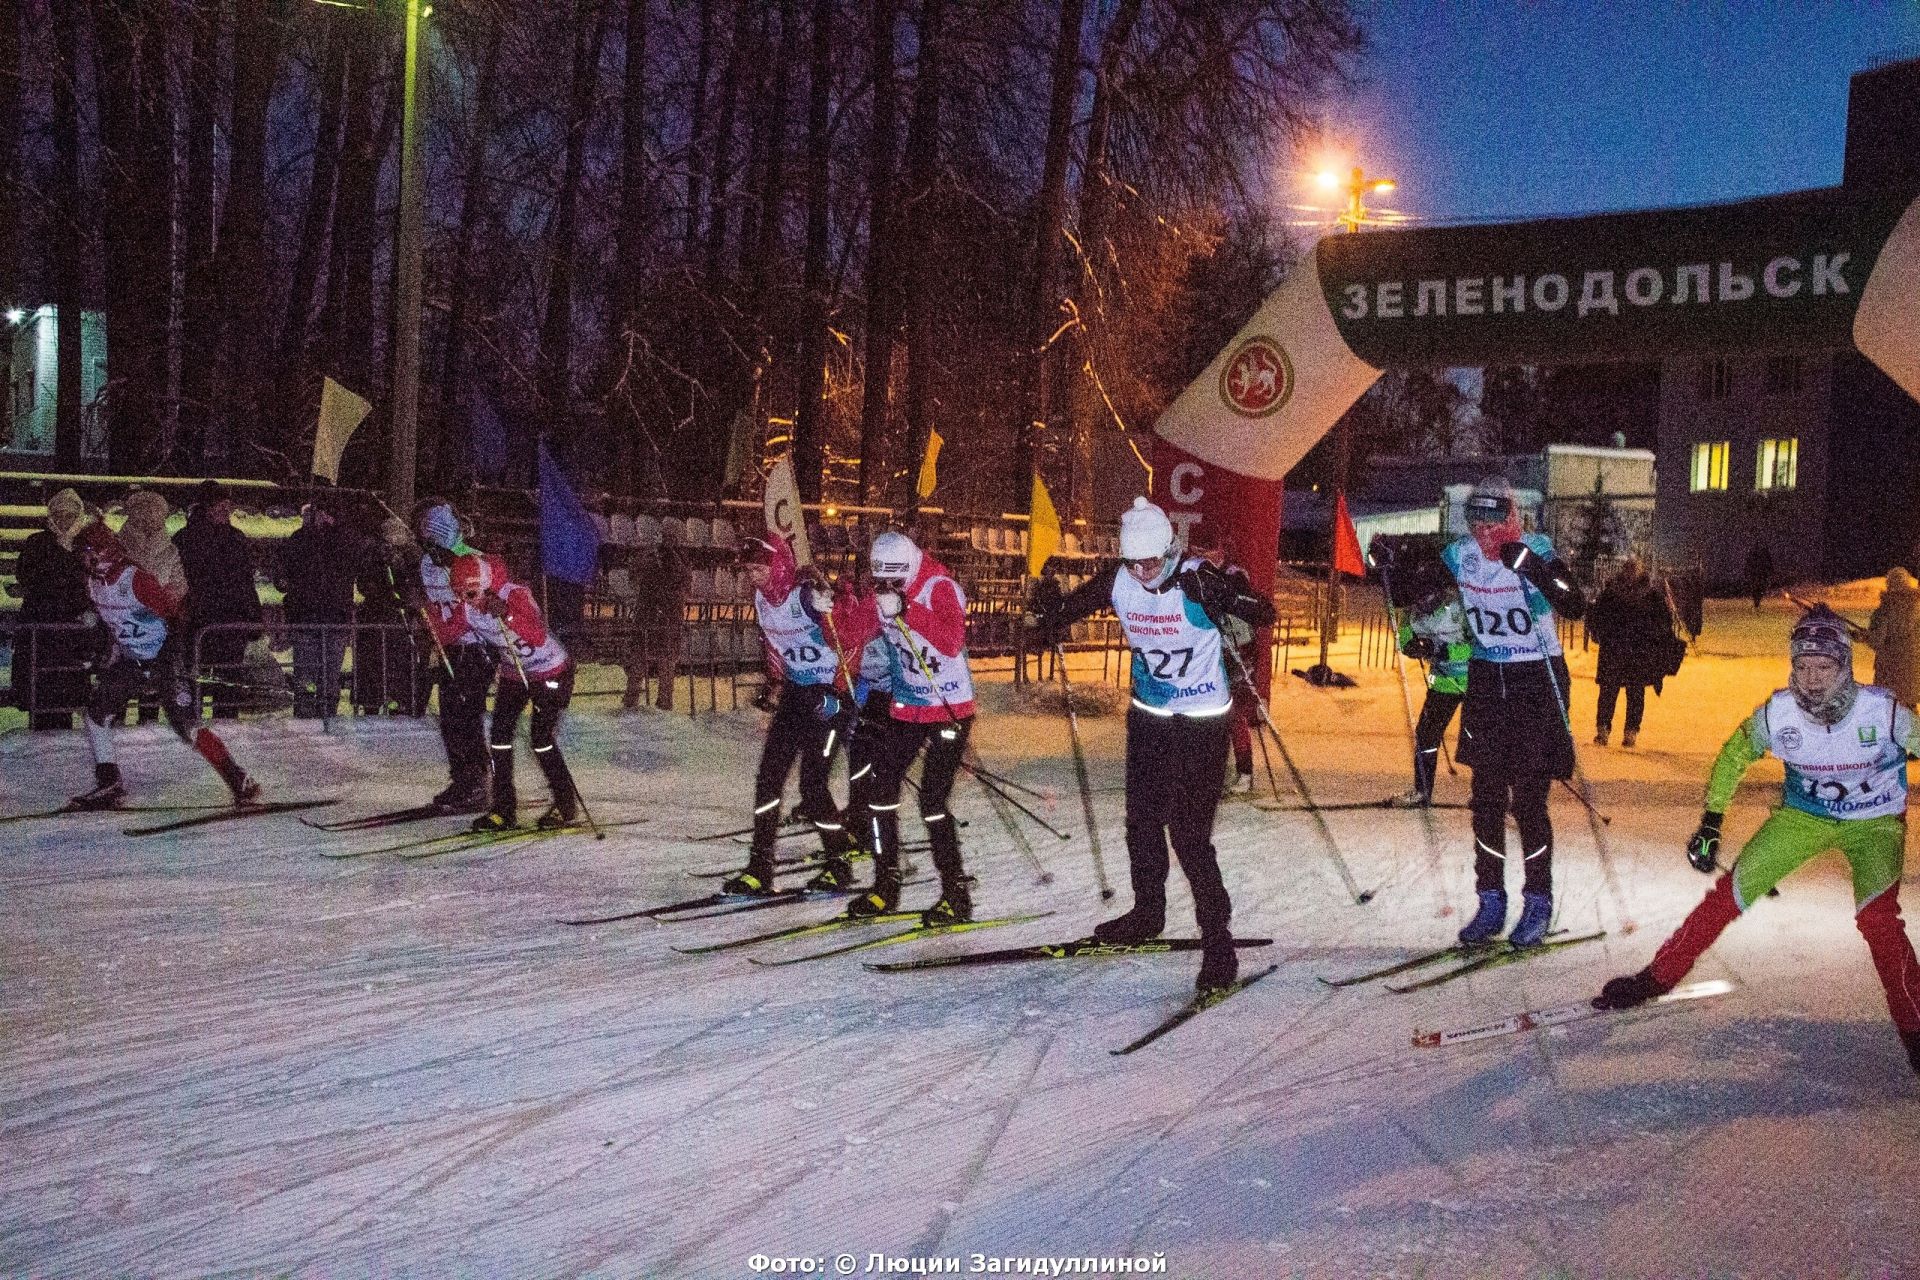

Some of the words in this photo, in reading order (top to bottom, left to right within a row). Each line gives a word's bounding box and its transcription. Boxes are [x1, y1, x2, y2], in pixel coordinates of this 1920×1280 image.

[1341, 252, 1852, 321] ЗЕЛЕНОДОЛЬСК
[1126, 612, 1182, 624] СПОРТИВНАЯ
[1467, 606, 1532, 636] 120
[1129, 625, 1161, 636] ШКОЛА
[1132, 646, 1194, 680] 127
[1075, 944, 1171, 957] FISCHER
